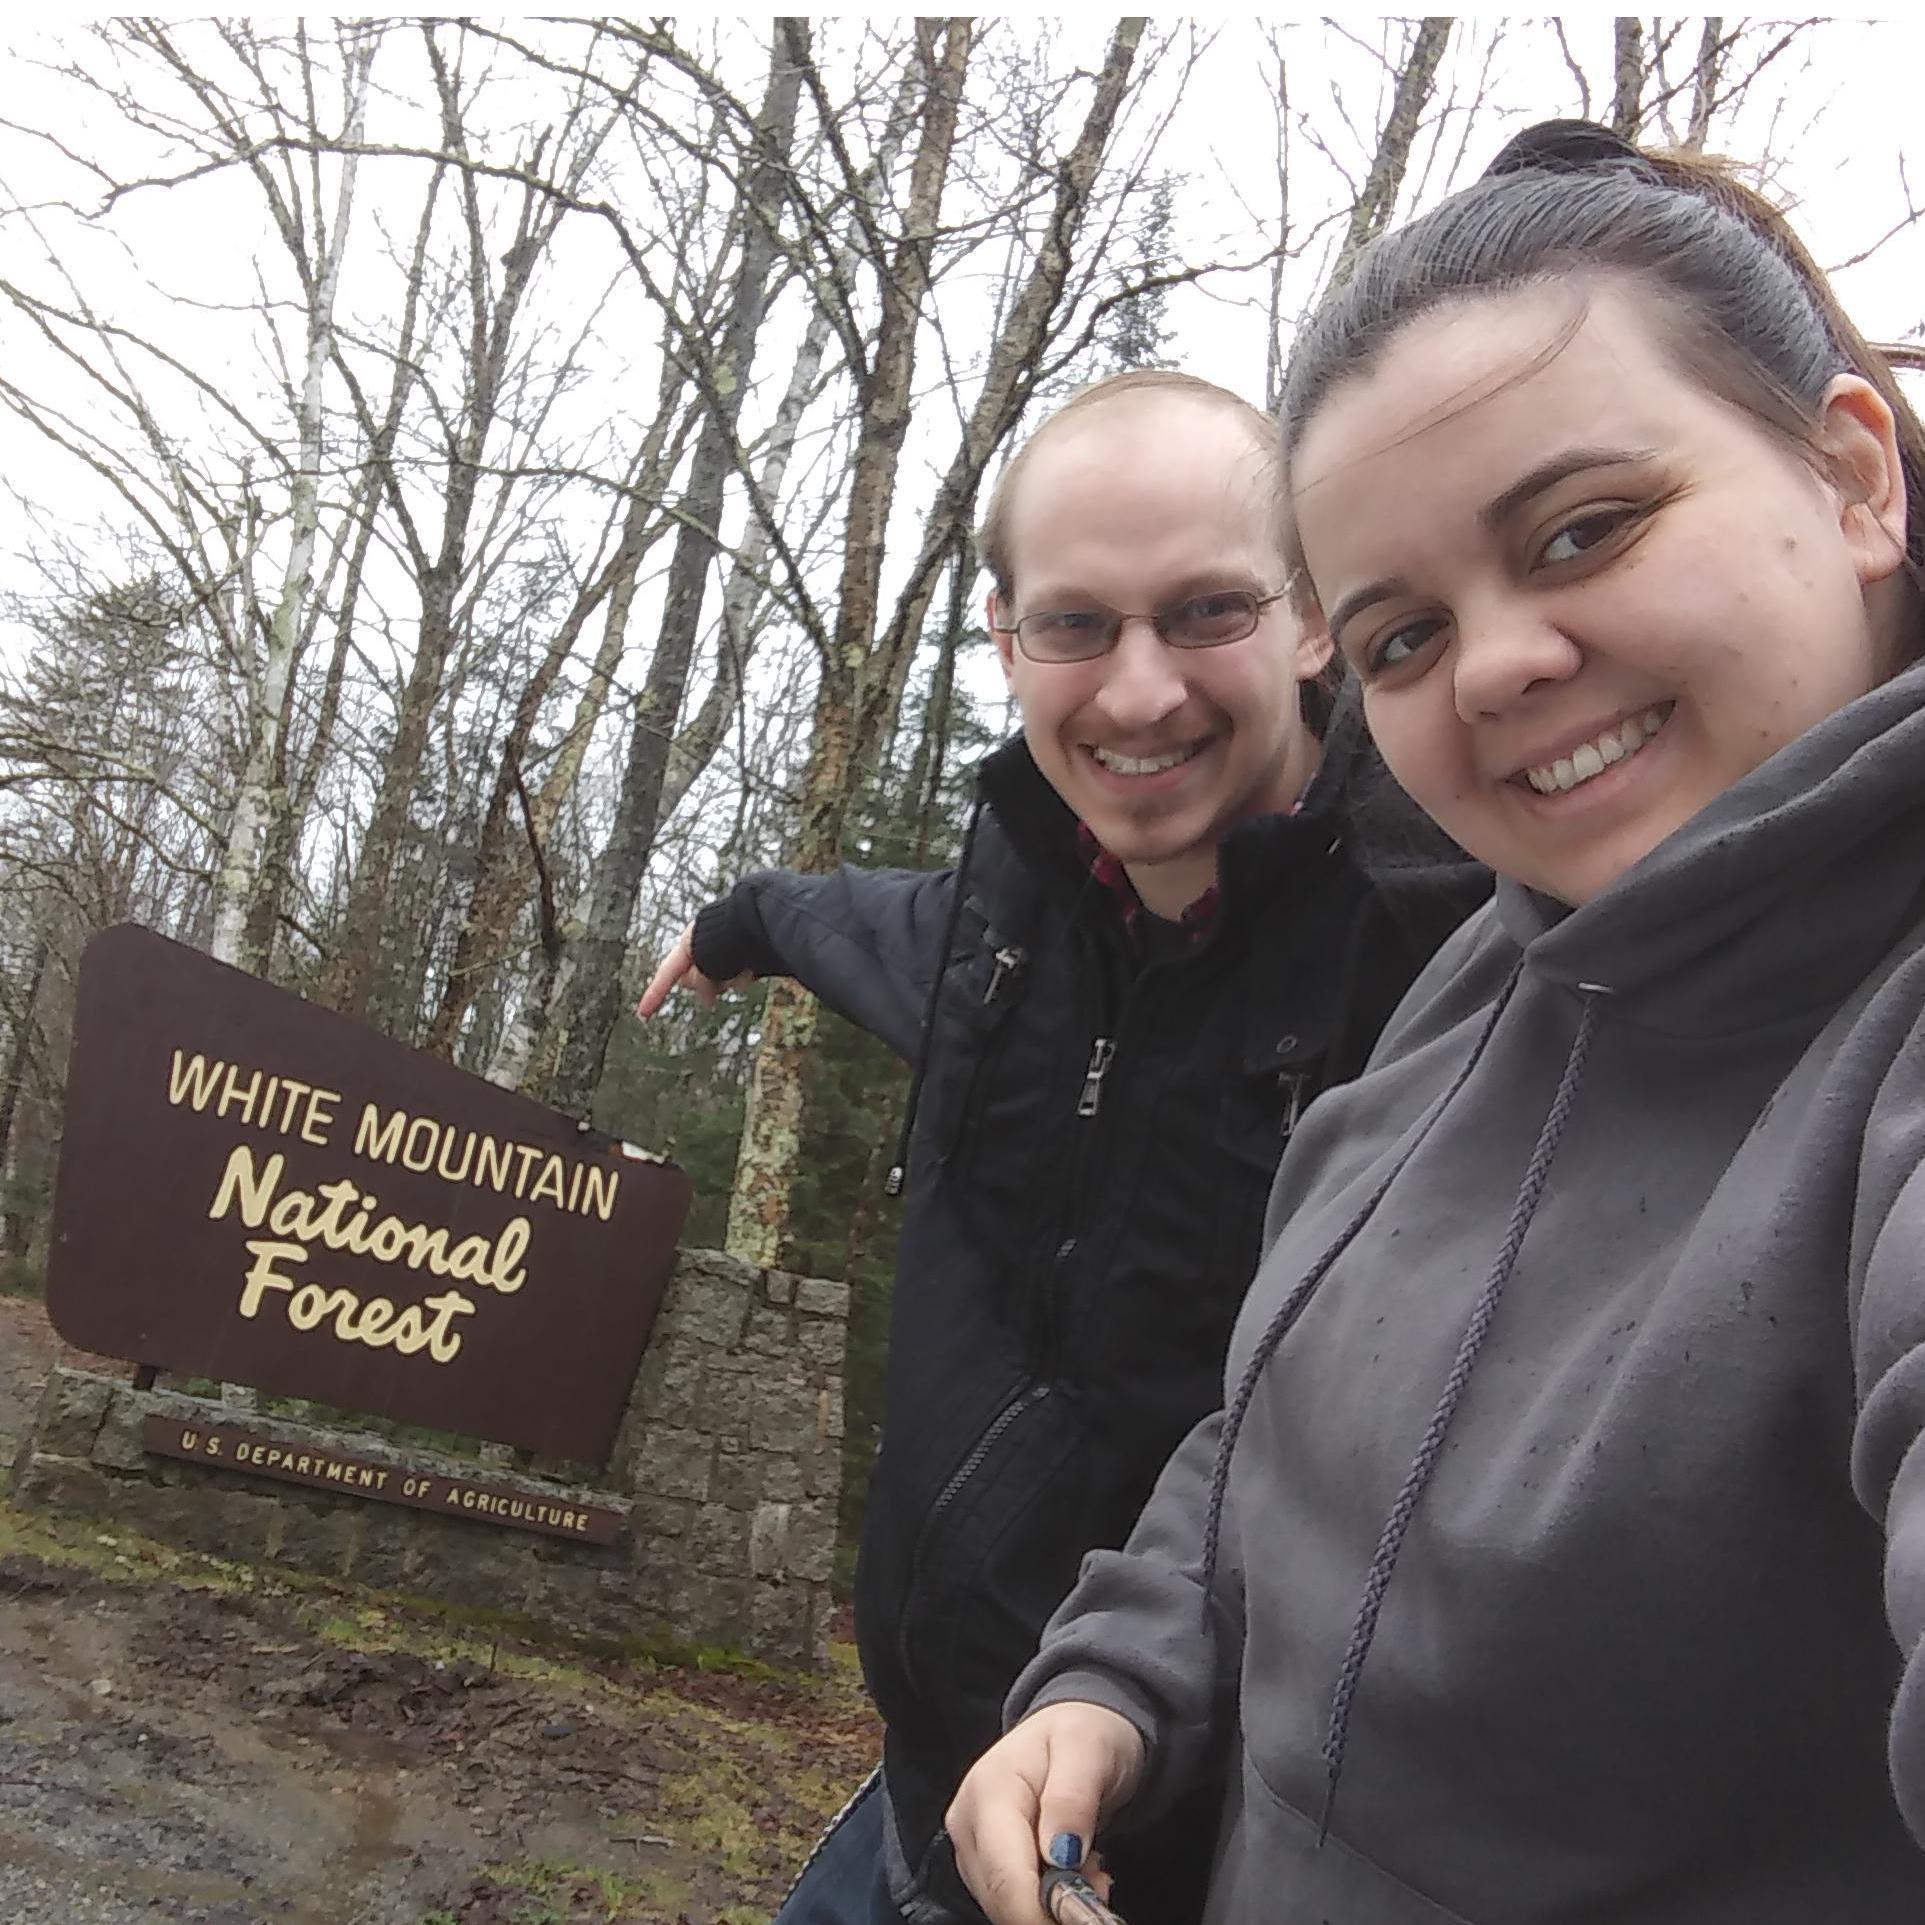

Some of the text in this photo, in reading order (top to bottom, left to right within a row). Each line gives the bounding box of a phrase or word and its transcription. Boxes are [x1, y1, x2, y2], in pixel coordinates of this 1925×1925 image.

[169, 1050, 618, 1220] WHITE MOUNTAIN
[209, 1146, 531, 1293] National
[239, 1241, 476, 1363] Forest
[236, 1442, 388, 1490] DEPARTMENT
[403, 1478, 431, 1498] OF
[446, 1488, 588, 1532] AGRICULTURE
